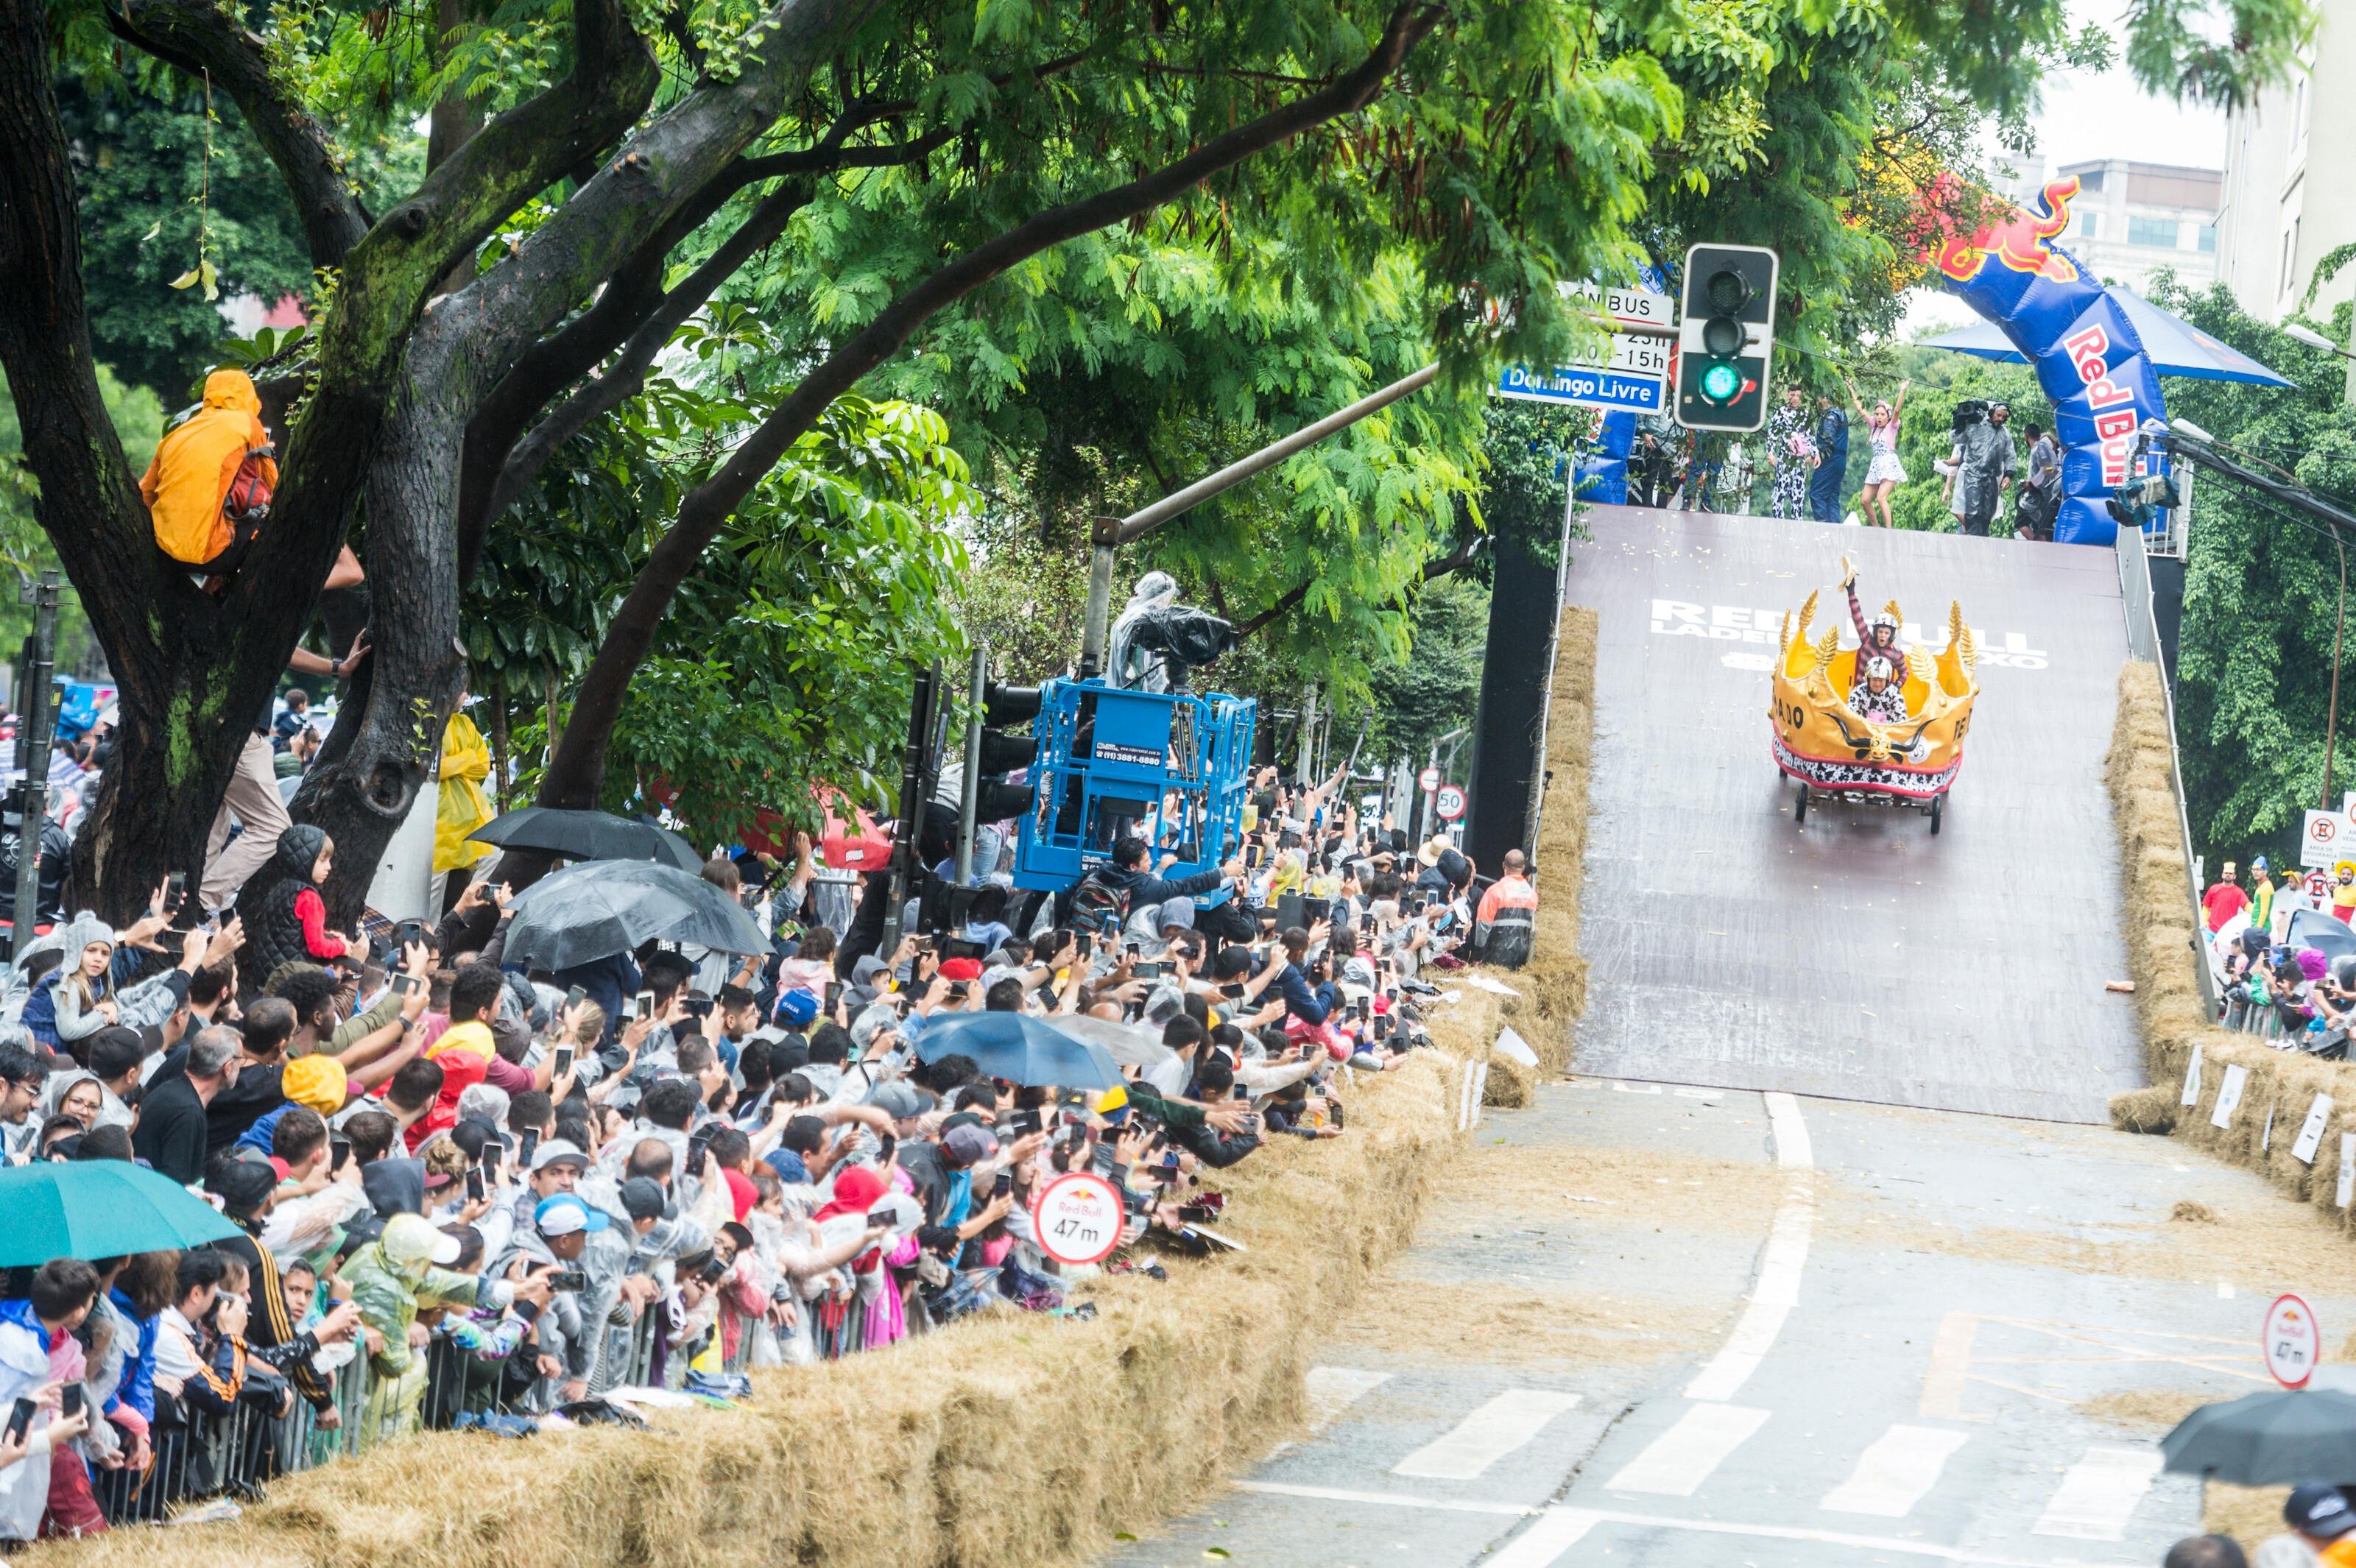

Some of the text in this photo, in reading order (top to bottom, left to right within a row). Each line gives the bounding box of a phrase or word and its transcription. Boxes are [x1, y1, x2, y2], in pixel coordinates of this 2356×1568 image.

[2064, 324, 2134, 410] Red
[1509, 368, 1651, 401] Domingo Livre
[1104, 752, 1116, 760] (11)
[1439, 794, 1460, 808] 50
[1058, 1201, 1103, 1218] Red Bull
